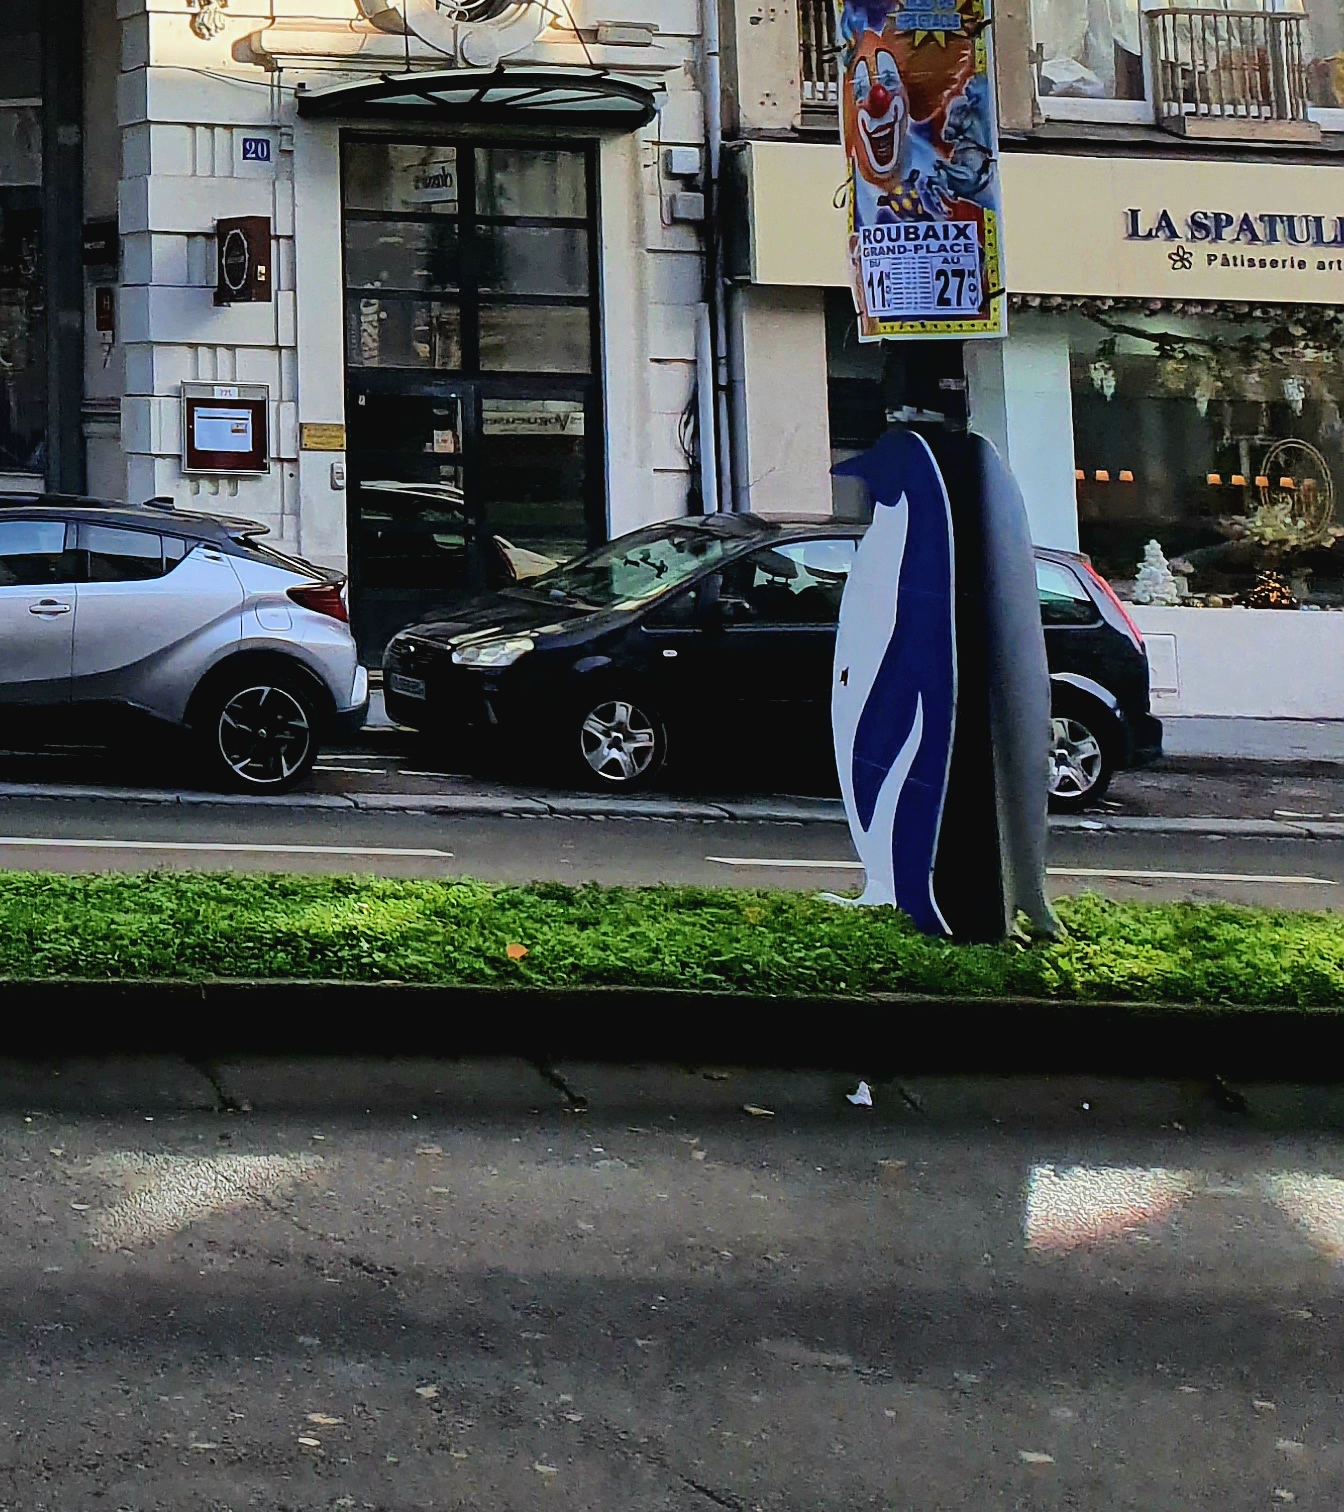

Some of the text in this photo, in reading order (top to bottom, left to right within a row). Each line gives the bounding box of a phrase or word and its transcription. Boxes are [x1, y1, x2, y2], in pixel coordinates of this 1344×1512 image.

[245, 140, 267, 159] 20
[862, 223, 973, 245] ROUBAIX
[1126, 208, 1183, 240] LA
[863, 243, 975, 258] GRAND-PLACE
[941, 257, 961, 265] AU
[1207, 252, 1307, 271] Pâtisserie
[868, 270, 886, 309] 11
[934, 268, 966, 307] 27
